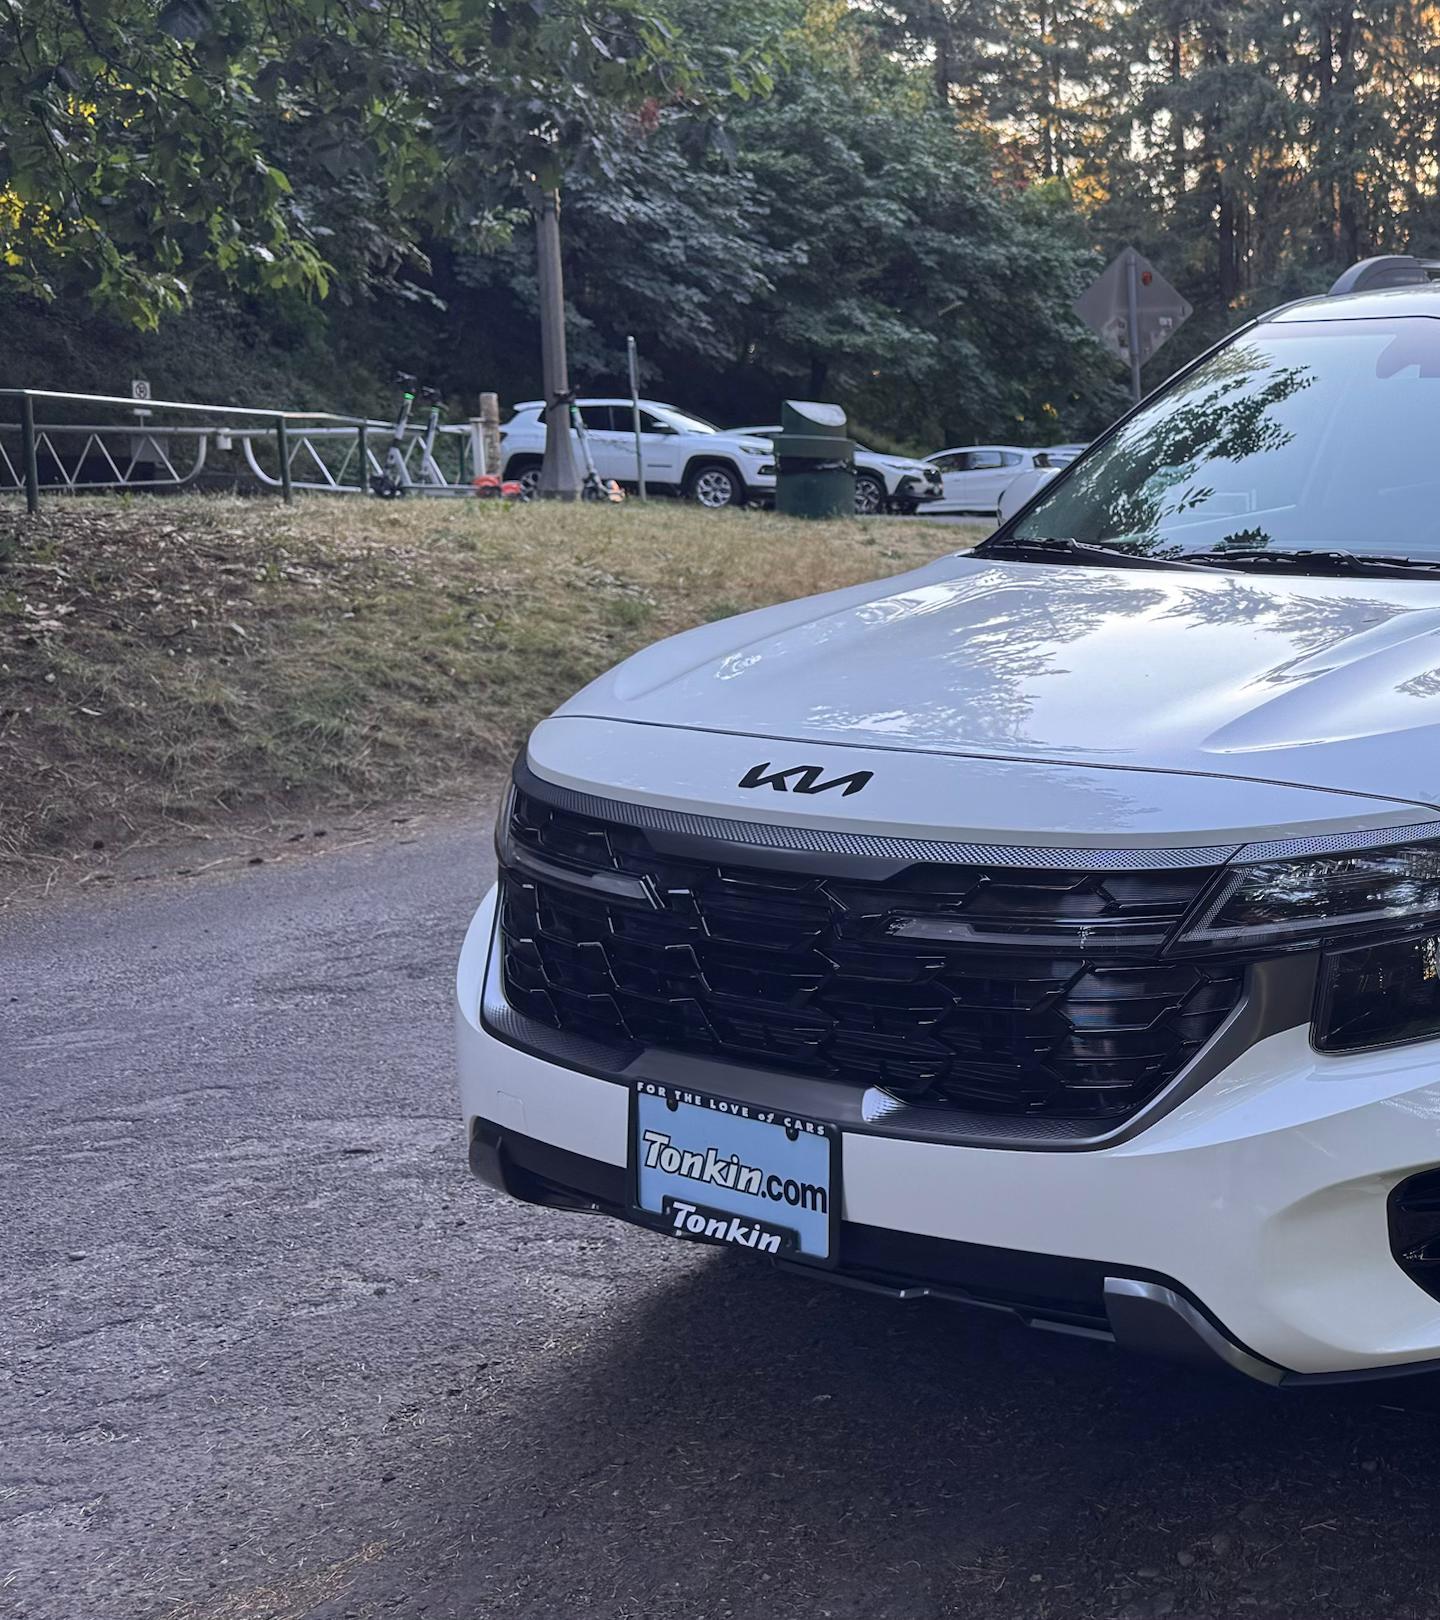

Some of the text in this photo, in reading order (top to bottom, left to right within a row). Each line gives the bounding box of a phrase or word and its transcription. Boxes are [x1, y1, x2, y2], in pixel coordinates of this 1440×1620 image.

[738, 762, 874, 797] KIA
[637, 1082, 826, 1136] FOR THE LOVE of CARS
[643, 1129, 827, 1214] Tonkin.com
[672, 1201, 782, 1254] Tonkin
